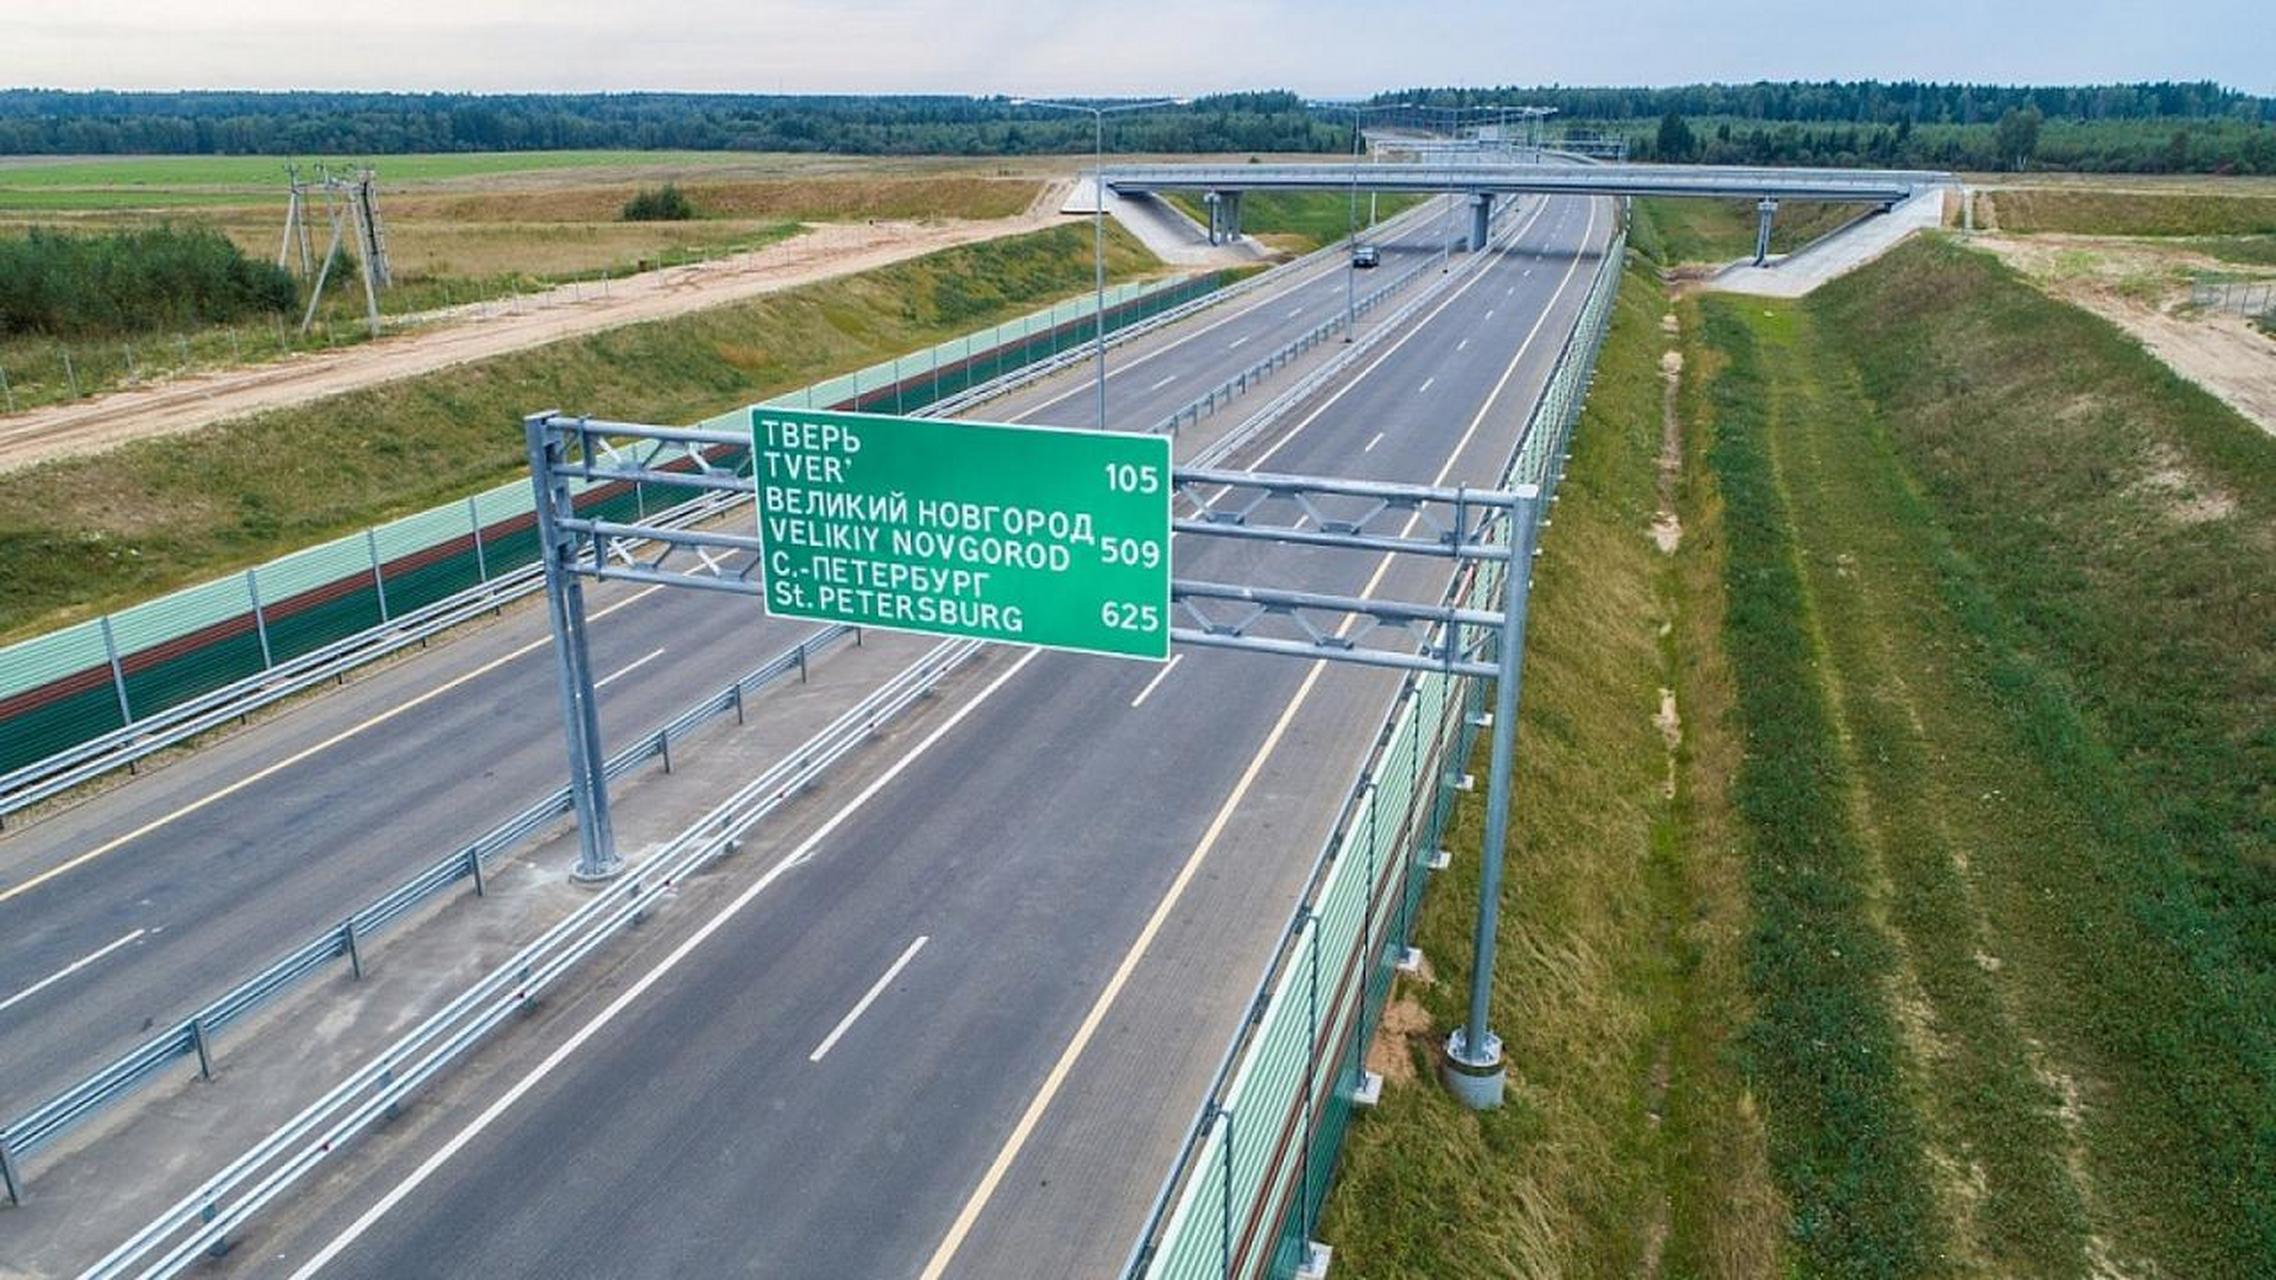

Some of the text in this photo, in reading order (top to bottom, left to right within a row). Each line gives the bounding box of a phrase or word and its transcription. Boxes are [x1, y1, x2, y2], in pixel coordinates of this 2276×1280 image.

[761, 419, 861, 453] ТВЕРЬ
[1105, 463, 1159, 494] 105
[766, 486, 1095, 545] ВЕЛИКИЙ НОВГОРОД
[769, 517, 1070, 572] VELIKIY NOVGOROD
[1101, 536, 1161, 569] 509
[772, 550, 990, 598] С.-ПЕТЕРБУРГ
[819, 585, 1023, 632] PETERSBURG
[1101, 601, 1159, 632] 625
